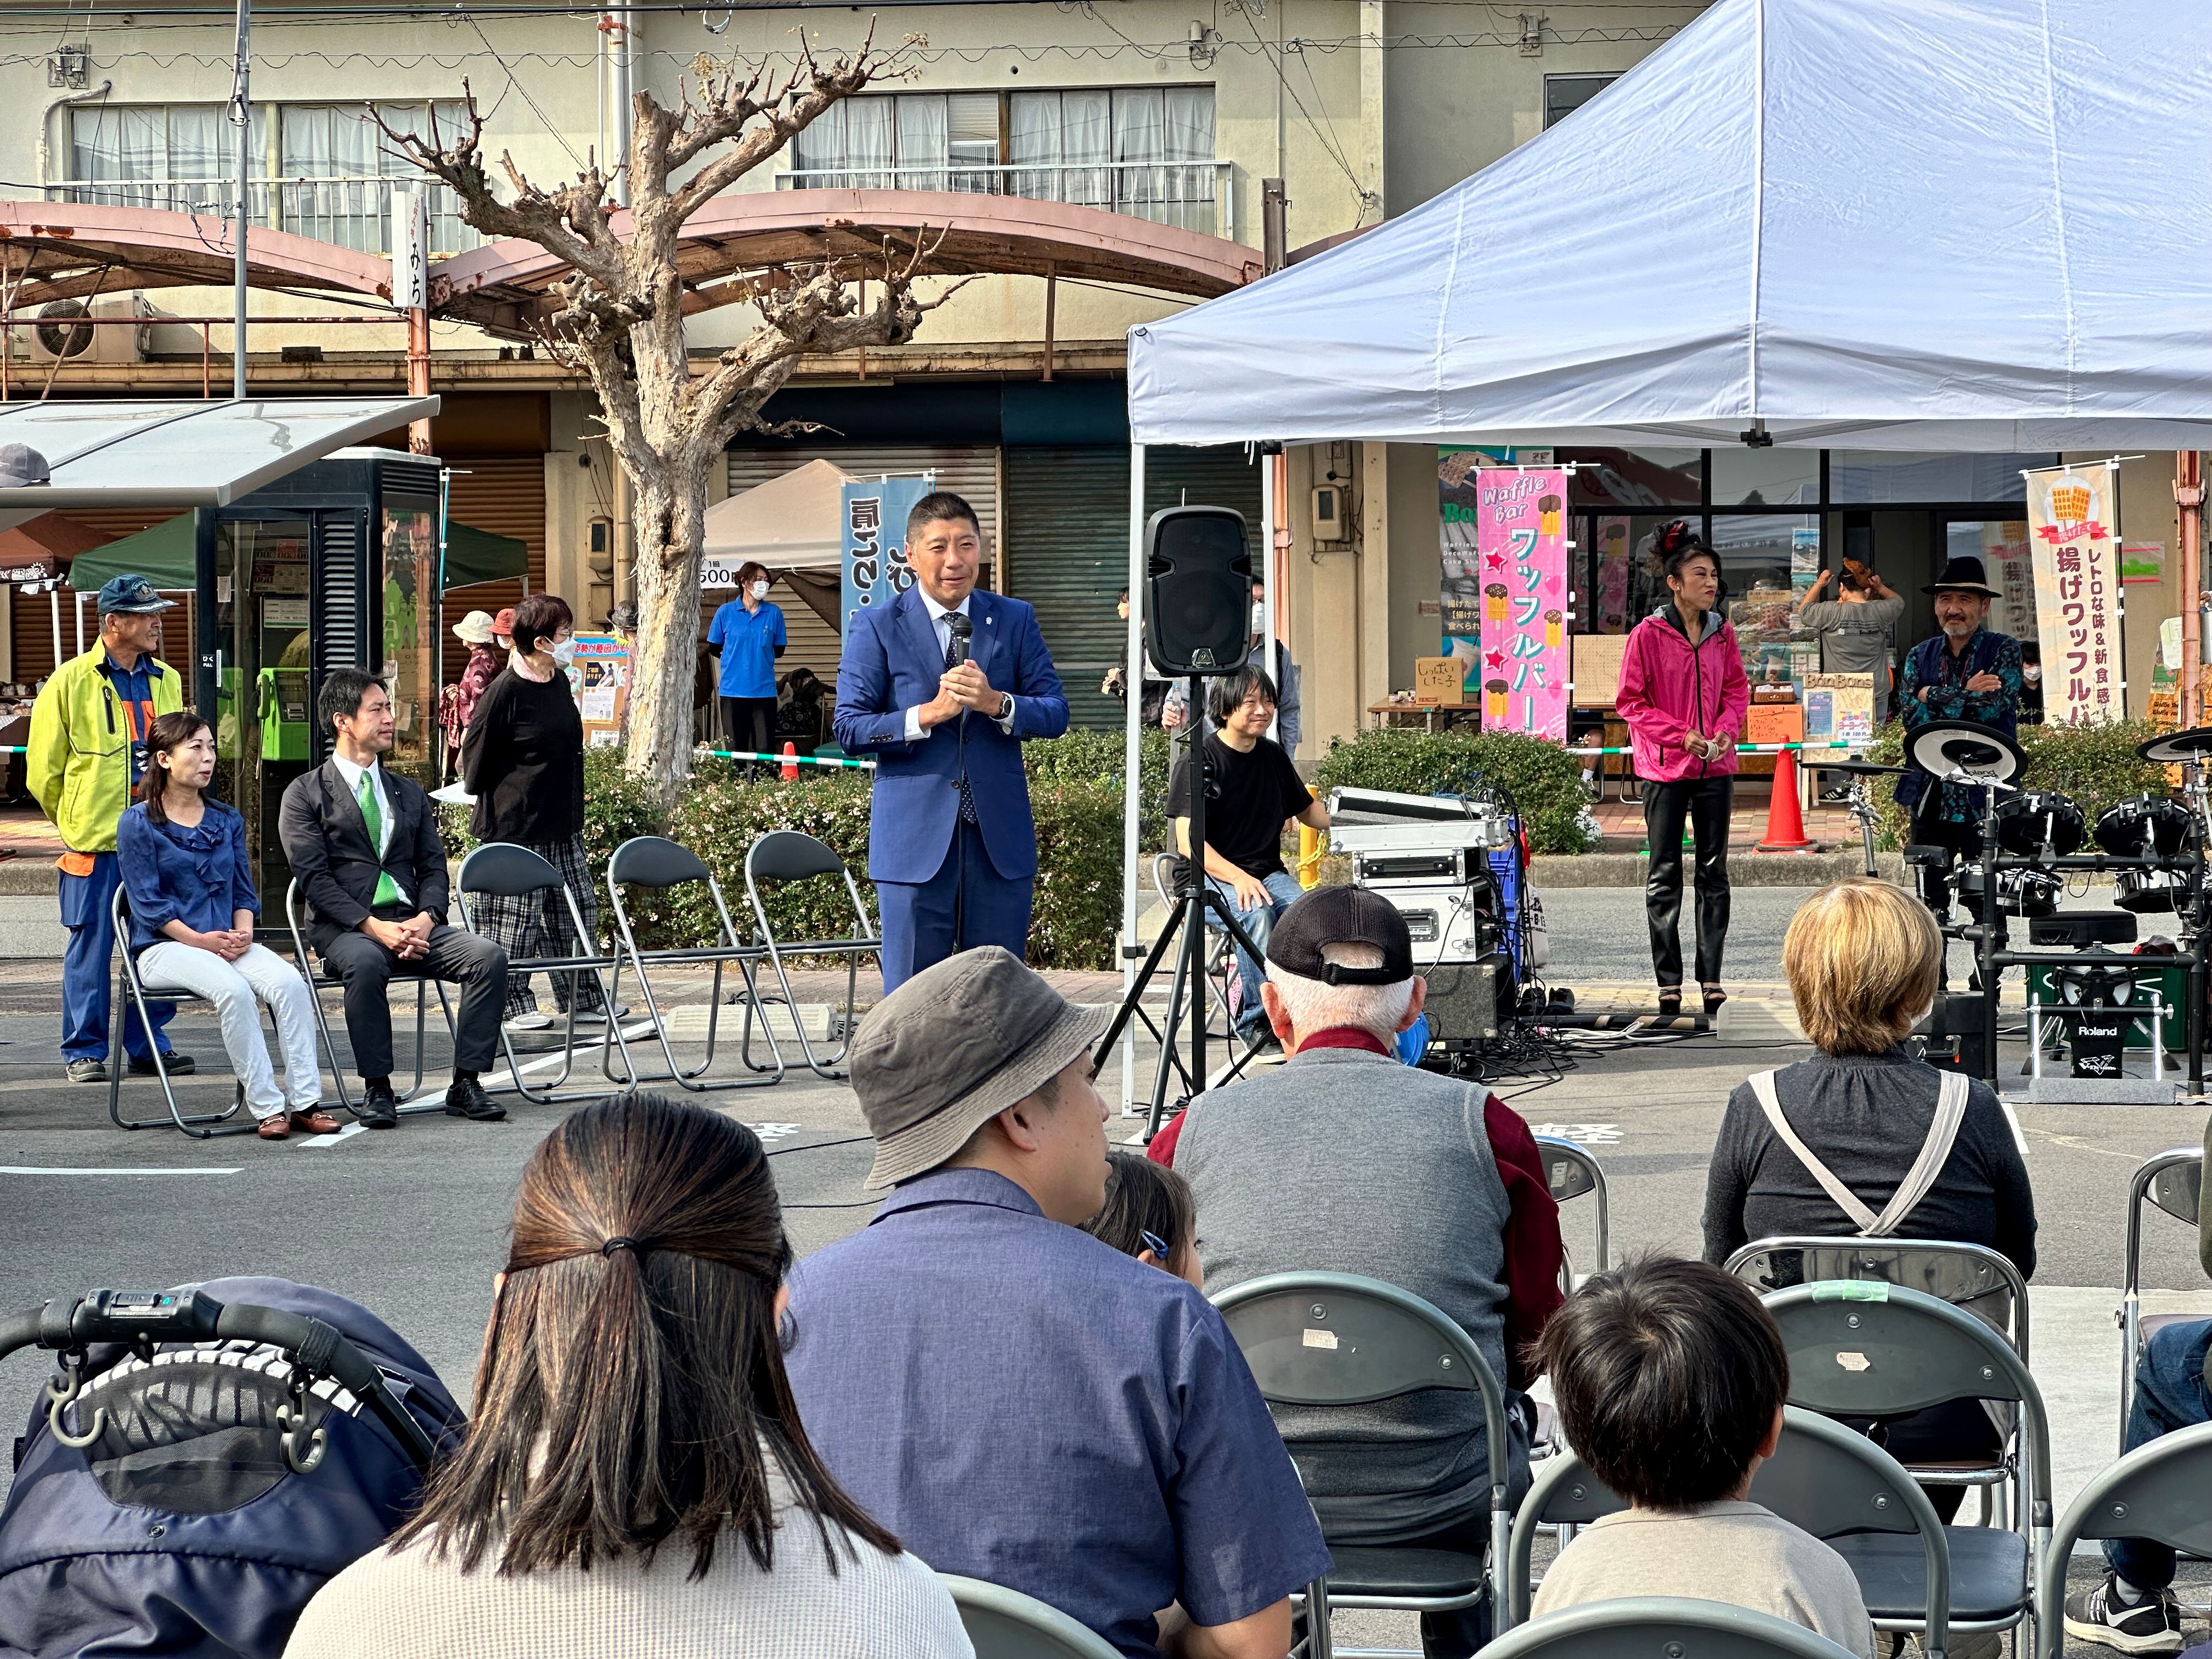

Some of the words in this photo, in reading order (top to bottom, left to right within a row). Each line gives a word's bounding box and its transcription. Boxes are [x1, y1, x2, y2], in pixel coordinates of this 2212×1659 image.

[410, 242, 420, 304] みち
[1483, 475, 1548, 507] Waffle
[1443, 503, 1477, 523] Bo
[1494, 501, 1528, 525] Bar
[2058, 523, 2092, 543] 揚げたて
[700, 569, 736, 583] 500
[1510, 527, 1546, 732] ワッフルバー
[574, 644, 629, 653] 姿勢が原因かも
[1418, 662, 1454, 675] しっぱい
[1424, 675, 1456, 687] した子
[2079, 1026, 2117, 1036] Roland
